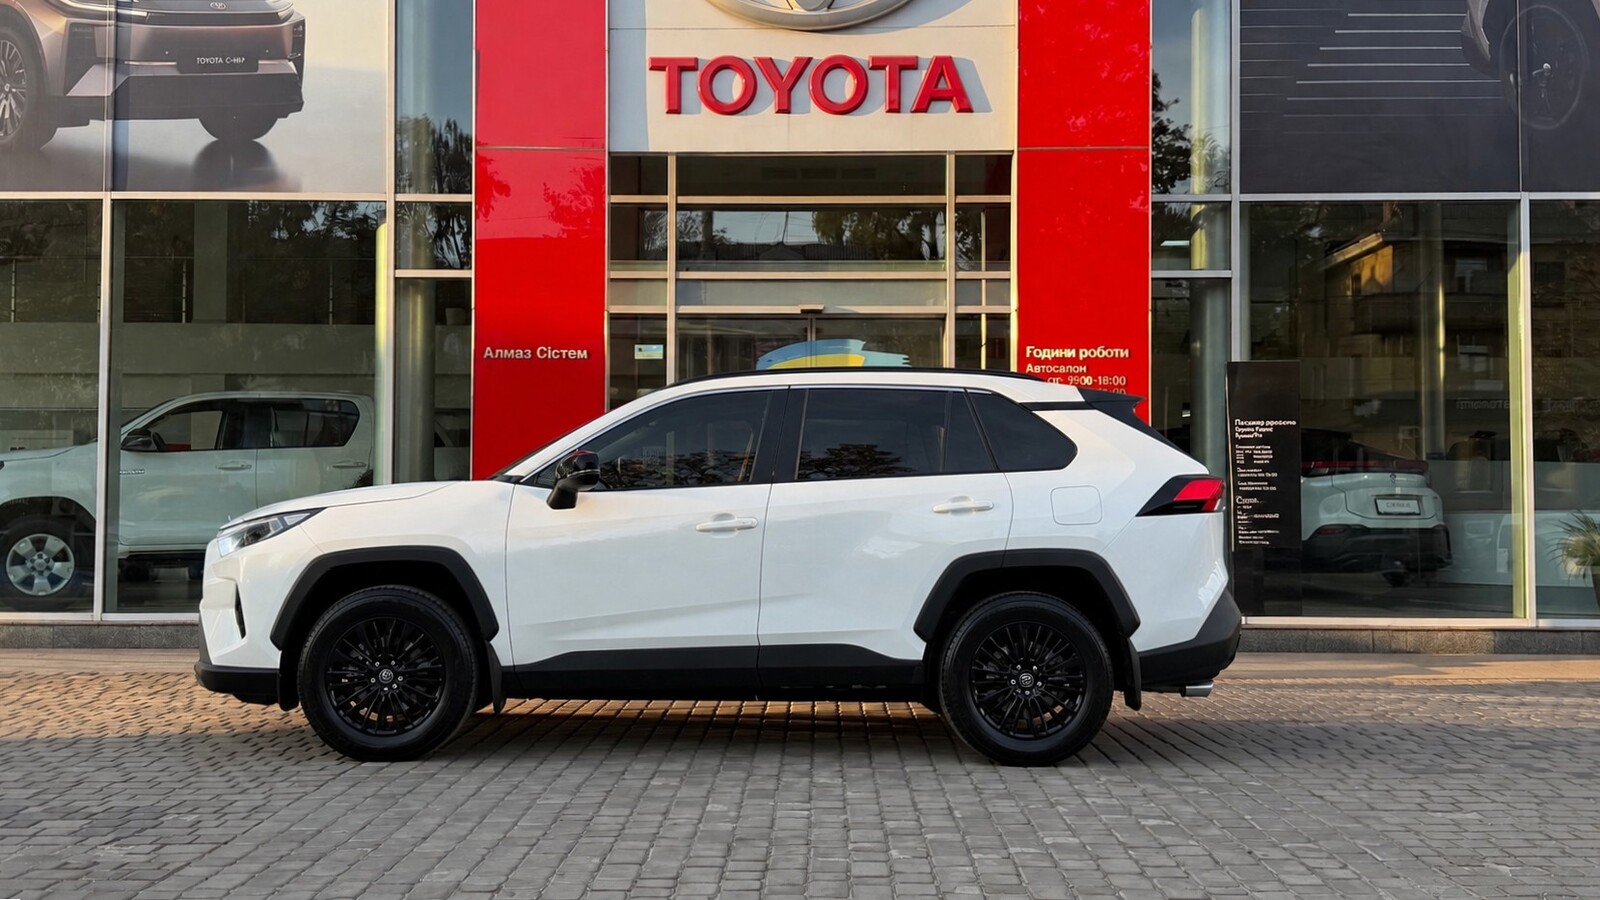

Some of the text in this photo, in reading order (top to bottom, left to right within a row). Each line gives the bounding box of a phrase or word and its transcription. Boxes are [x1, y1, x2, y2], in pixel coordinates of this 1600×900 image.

[196, 57, 224, 65] TOYOTA
[649, 55, 974, 115] TOYOTA
[483, 346, 589, 360] Алмаз Сістем
[1079, 345, 1130, 361] роботи
[1025, 363, 1088, 374] Автосалон
